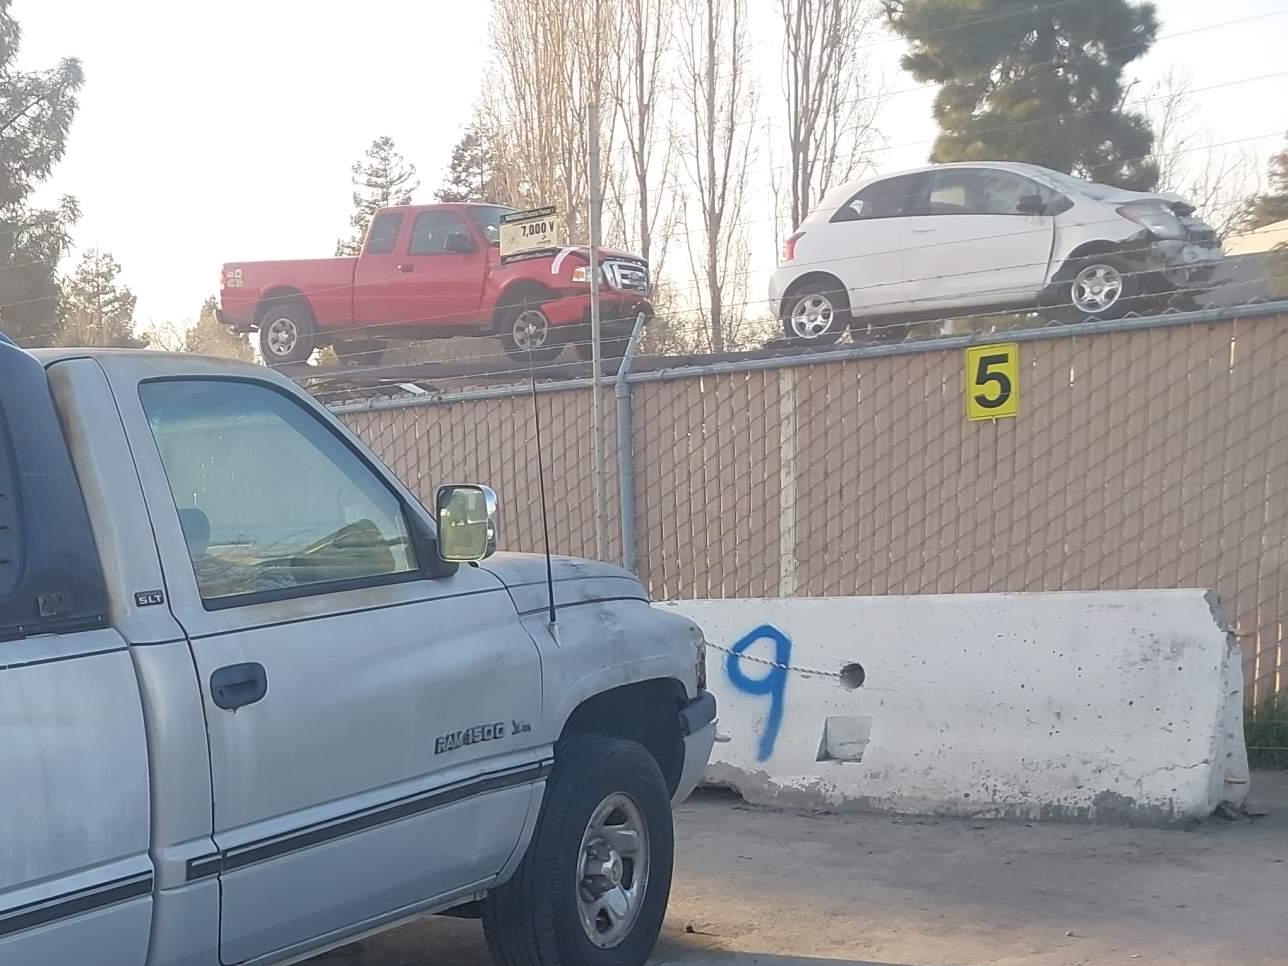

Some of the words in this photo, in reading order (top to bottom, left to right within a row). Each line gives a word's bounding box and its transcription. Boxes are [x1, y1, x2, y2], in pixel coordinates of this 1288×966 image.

[521, 222, 547, 237] 7,000
[974, 352, 1011, 408] 5
[138, 594, 162, 605] SLT
[726, 623, 793, 763] 9
[434, 731, 465, 755] RAM
[463, 721, 505, 746] 1500
